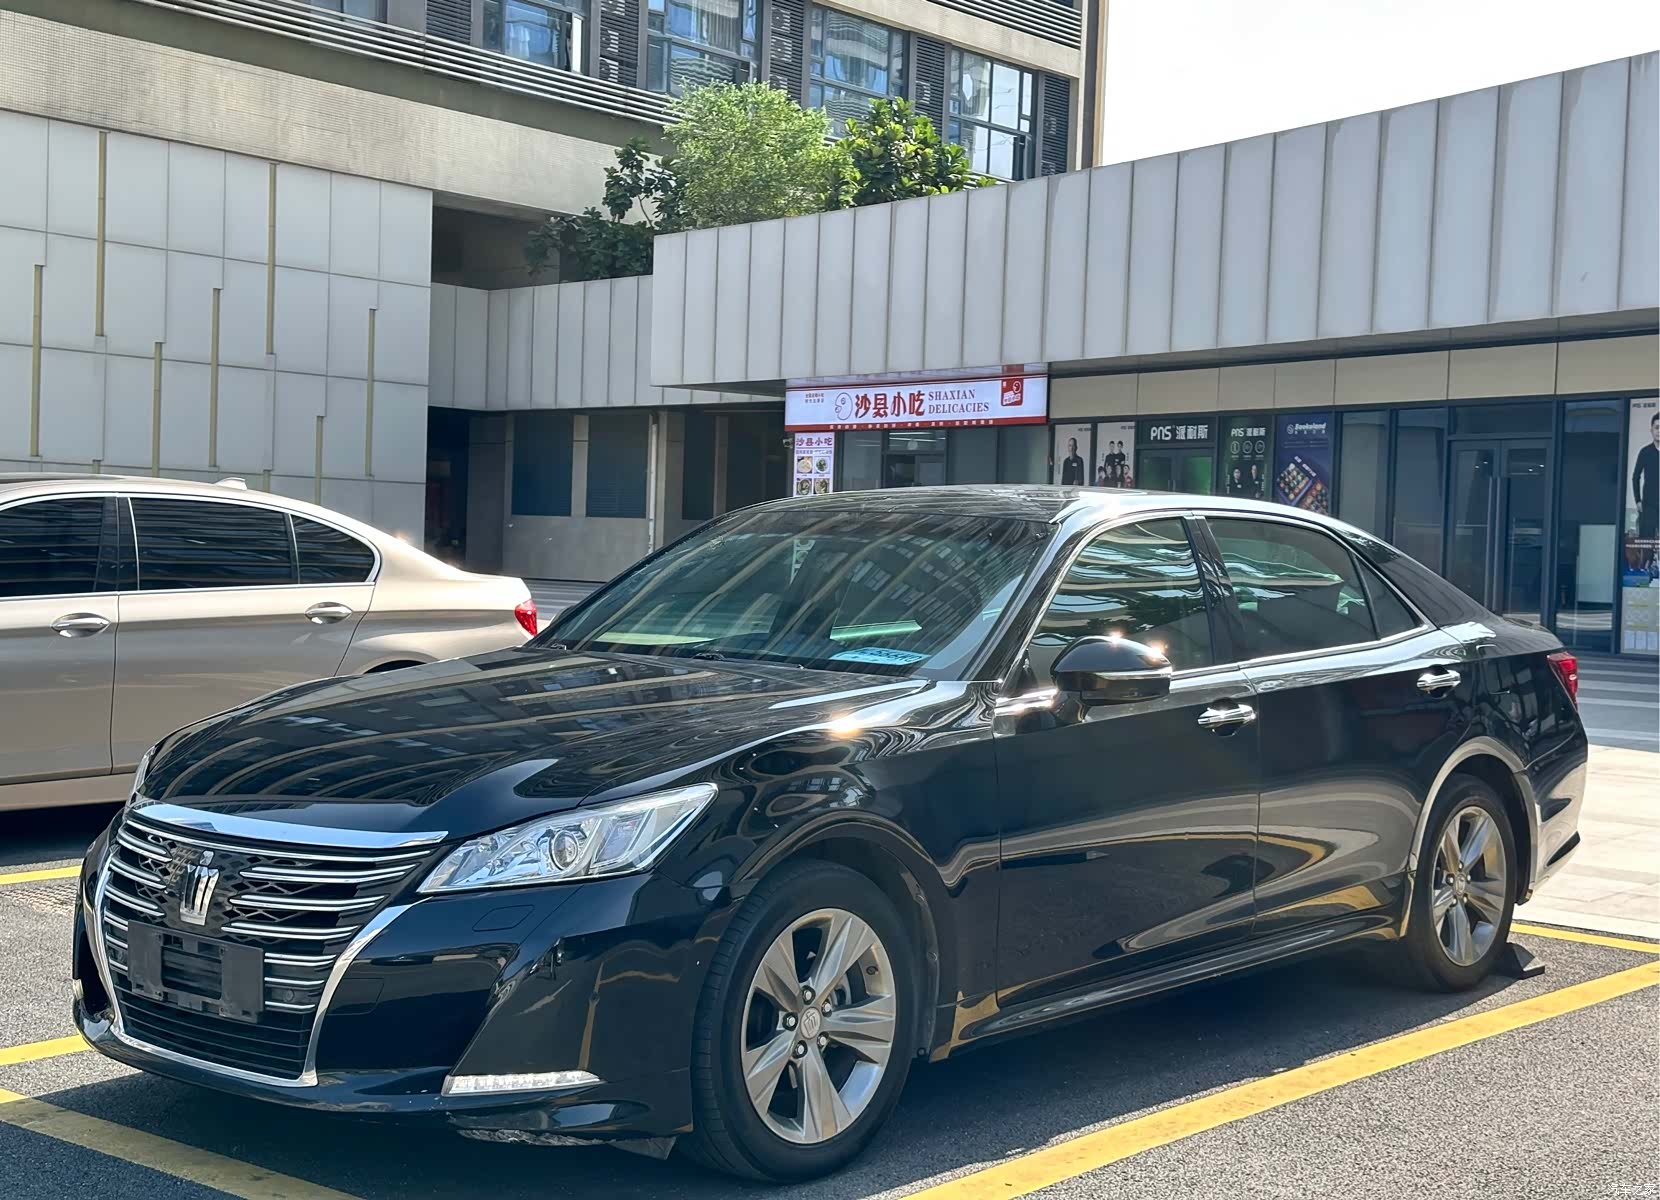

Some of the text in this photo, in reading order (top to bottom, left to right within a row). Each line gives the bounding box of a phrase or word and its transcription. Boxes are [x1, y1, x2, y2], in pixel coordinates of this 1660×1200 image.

[928, 388, 976, 402] SHAXIAN
[855, 390, 925, 418] 沙县小吃
[928, 402, 989, 414] DELICACIES
[1176, 425, 1208, 439] 派耐斯
[796, 437, 833, 446] 沙县小吃
